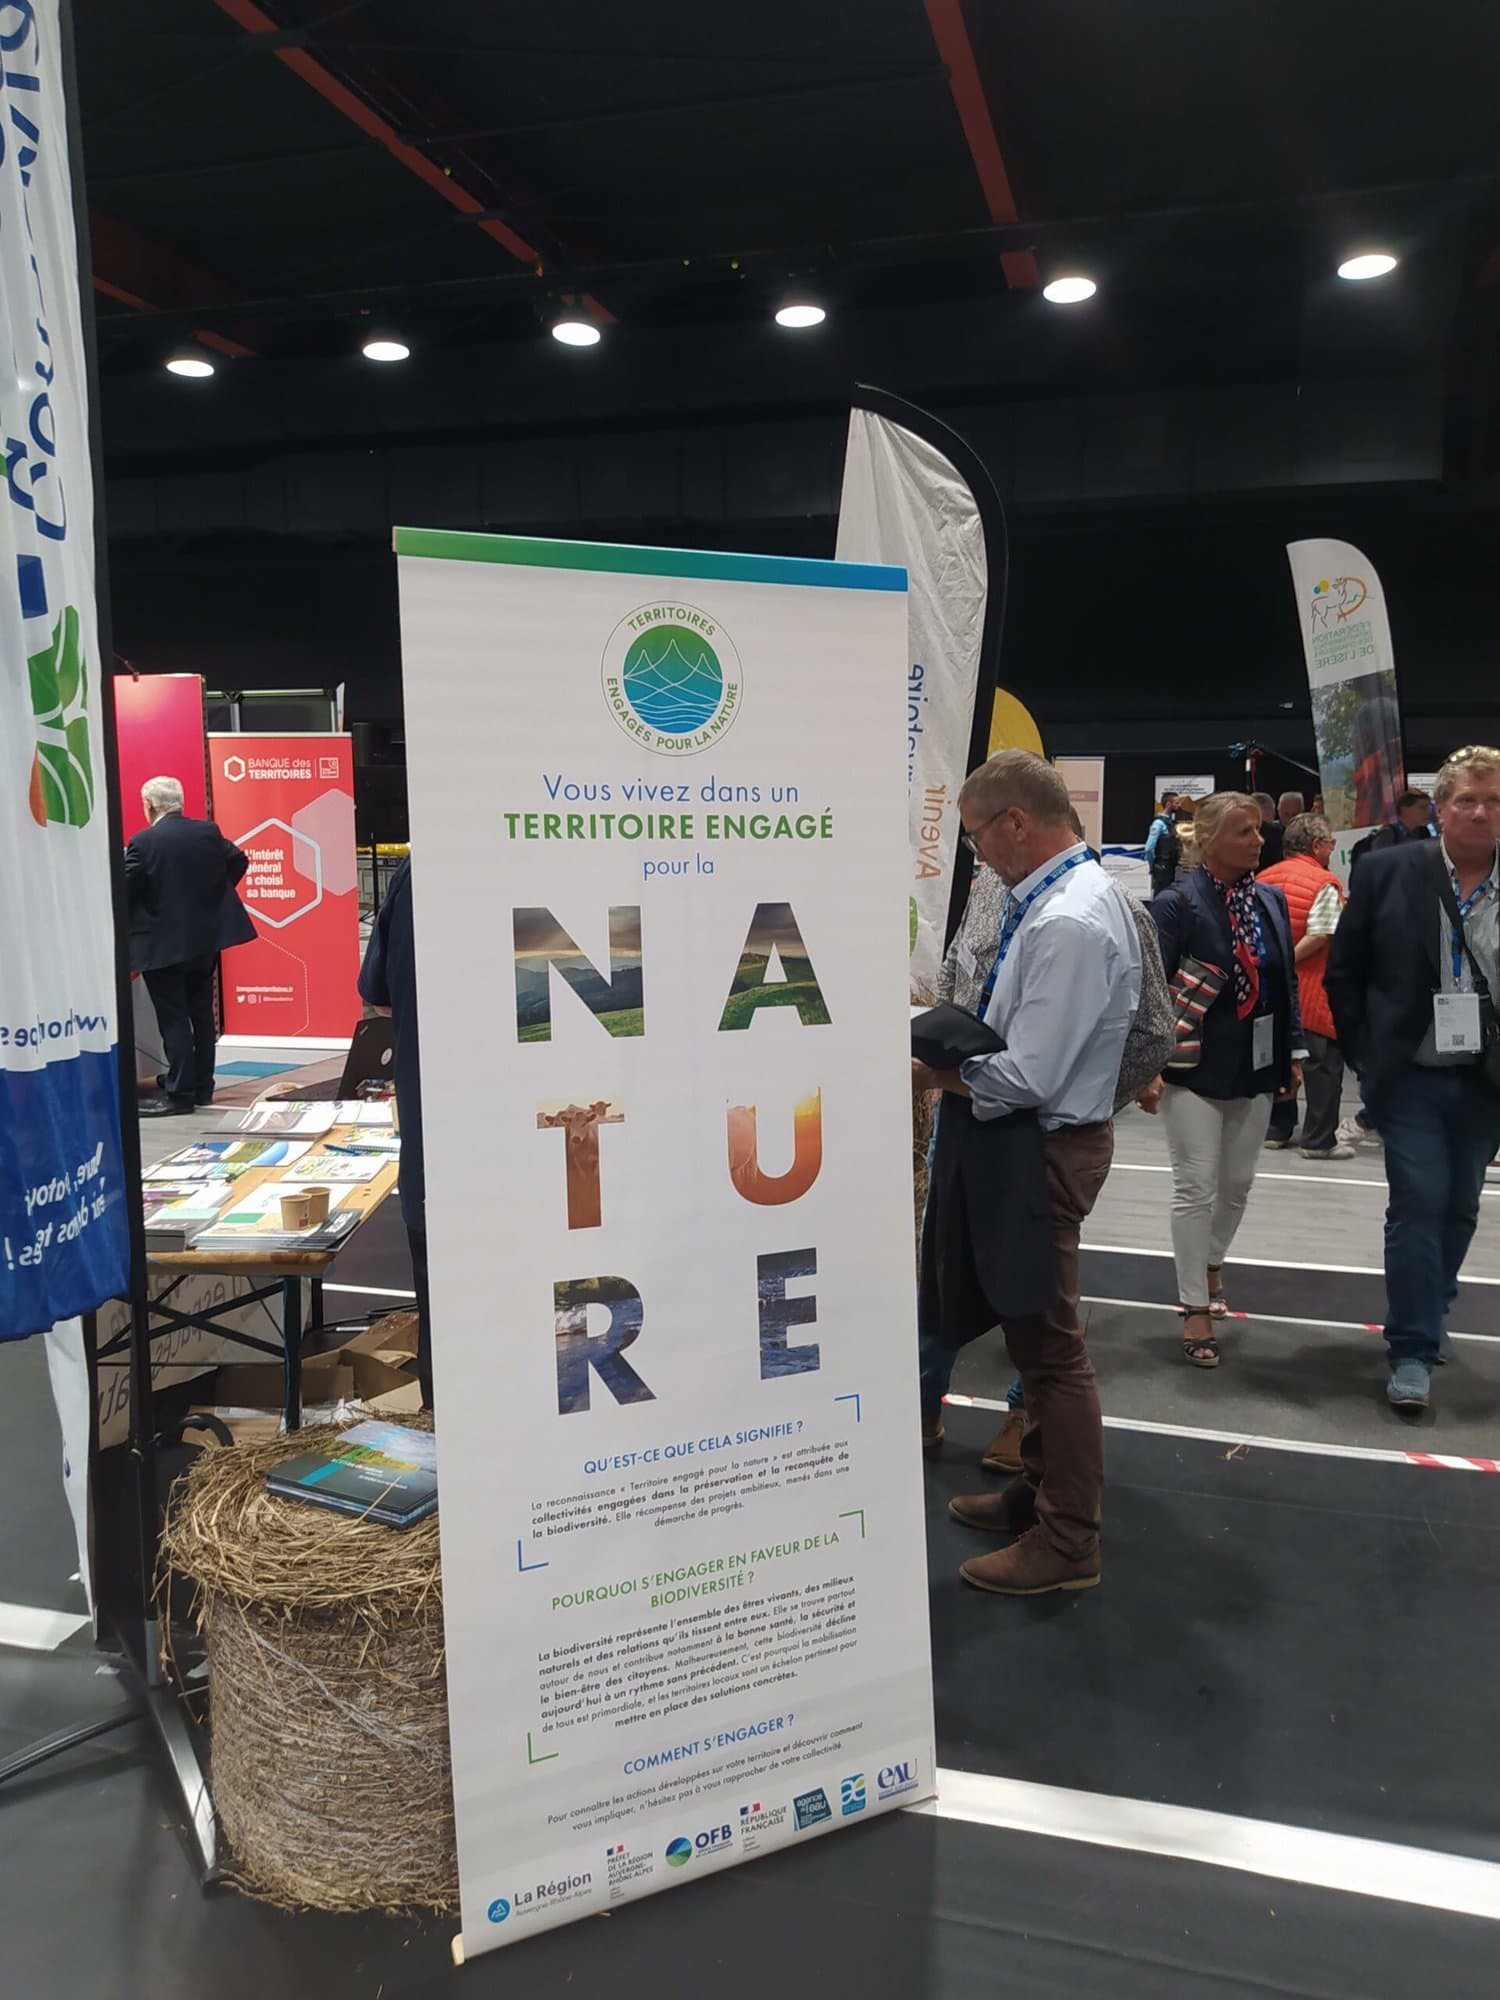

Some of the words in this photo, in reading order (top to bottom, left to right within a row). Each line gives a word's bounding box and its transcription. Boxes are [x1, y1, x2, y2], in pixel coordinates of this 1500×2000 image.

[627, 607, 716, 636] TERRITOIRES
[656, 736, 693, 750] POUR
[694, 731, 712, 746] LA
[710, 682, 738, 734] NATURE
[248, 758, 290, 769] BANQUE
[292, 758, 311, 768] des
[248, 769, 312, 780] TERRITOIRES
[543, 774, 612, 801] Vous
[621, 777, 691, 802] vivez
[700, 775, 761, 803] dans
[771, 785, 799, 803] un
[503, 813, 694, 840] TERRITOIRE
[706, 807, 833, 839] ENGAGÉ
[246, 877, 253, 885] a
[254, 874, 283, 885] choisi
[643, 858, 690, 881] pour
[696, 852, 715, 875] la
[247, 889, 258, 898] sa
[260, 887, 296, 900] banque
[512, 904, 645, 1043] N
[717, 902, 833, 1031] A
[536, 1100, 625, 1229] T
[727, 1087, 823, 1206] U
[553, 1275, 657, 1415] R
[757, 1248, 820, 1380] E
[584, 1448, 659, 1473] QU'EST-CE
[664, 1441, 694, 1458] QUE
[698, 1434, 732, 1451] CELA
[735, 1422, 792, 1444] SIGNIFIE
[796, 1420, 803, 1432] ?
[532, 1504, 592, 1524] collectivités
[597, 1495, 646, 1511] engagées
[651, 1489, 674, 1500] dans
[693, 1472, 753, 1493] préservation
[784, 1455, 833, 1472] reconquête
[552, 1579, 636, 1610] POURQUOI
[641, 1558, 724, 1589] S'ENGAGER
[728, 1552, 746, 1568] EN
[750, 1540, 800, 1563] FAVEUR
[804, 1535, 820, 1550] DE
[823, 1531, 839, 1545] LA
[650, 1573, 744, 1608] BIODIVERSITÉ
[747, 1570, 754, 1583] ?
[552, 1634, 613, 1657] biodiversité
[615, 1623, 667, 1642] représente
[670, 1607, 721, 1628] l'ensemble
[723, 1604, 740, 1614] des
[742, 1598, 764, 1609] êtres
[804, 1583, 820, 1593] des
[822, 1575, 854, 1589] milieux
[737, 1625, 766, 1637] bonne
[811, 1602, 844, 1618] sécurité
[538, 1657, 580, 1676] naturels
[596, 1651, 613, 1661] des
[616, 1639, 659, 1656] relations
[691, 1621, 721, 1636] tissent
[723, 1616, 747, 1627] entre
[554, 1682, 600, 1700] bien-être
[605, 1676, 622, 1687] des
[825, 1614, 856, 1627] décline
[628, 1680, 664, 1696] rythme
[666, 1673, 687, 1685] sans
[614, 1713, 646, 1727] mettre
[663, 1700, 688, 1716] place
[690, 1694, 707, 1705] des
[710, 1683, 750, 1700] solutions
[623, 1741, 699, 1774] COMMENT
[703, 1716, 783, 1751] S'ENGAGER
[787, 1713, 794, 1726] ?
[740, 1806, 787, 1826] RÉPUBLIQUE
[741, 1816, 784, 1835] FRANÇAISE
[695, 1824, 732, 1848] OFB
[514, 1891, 532, 1906] La
[536, 1873, 592, 1899] Région
